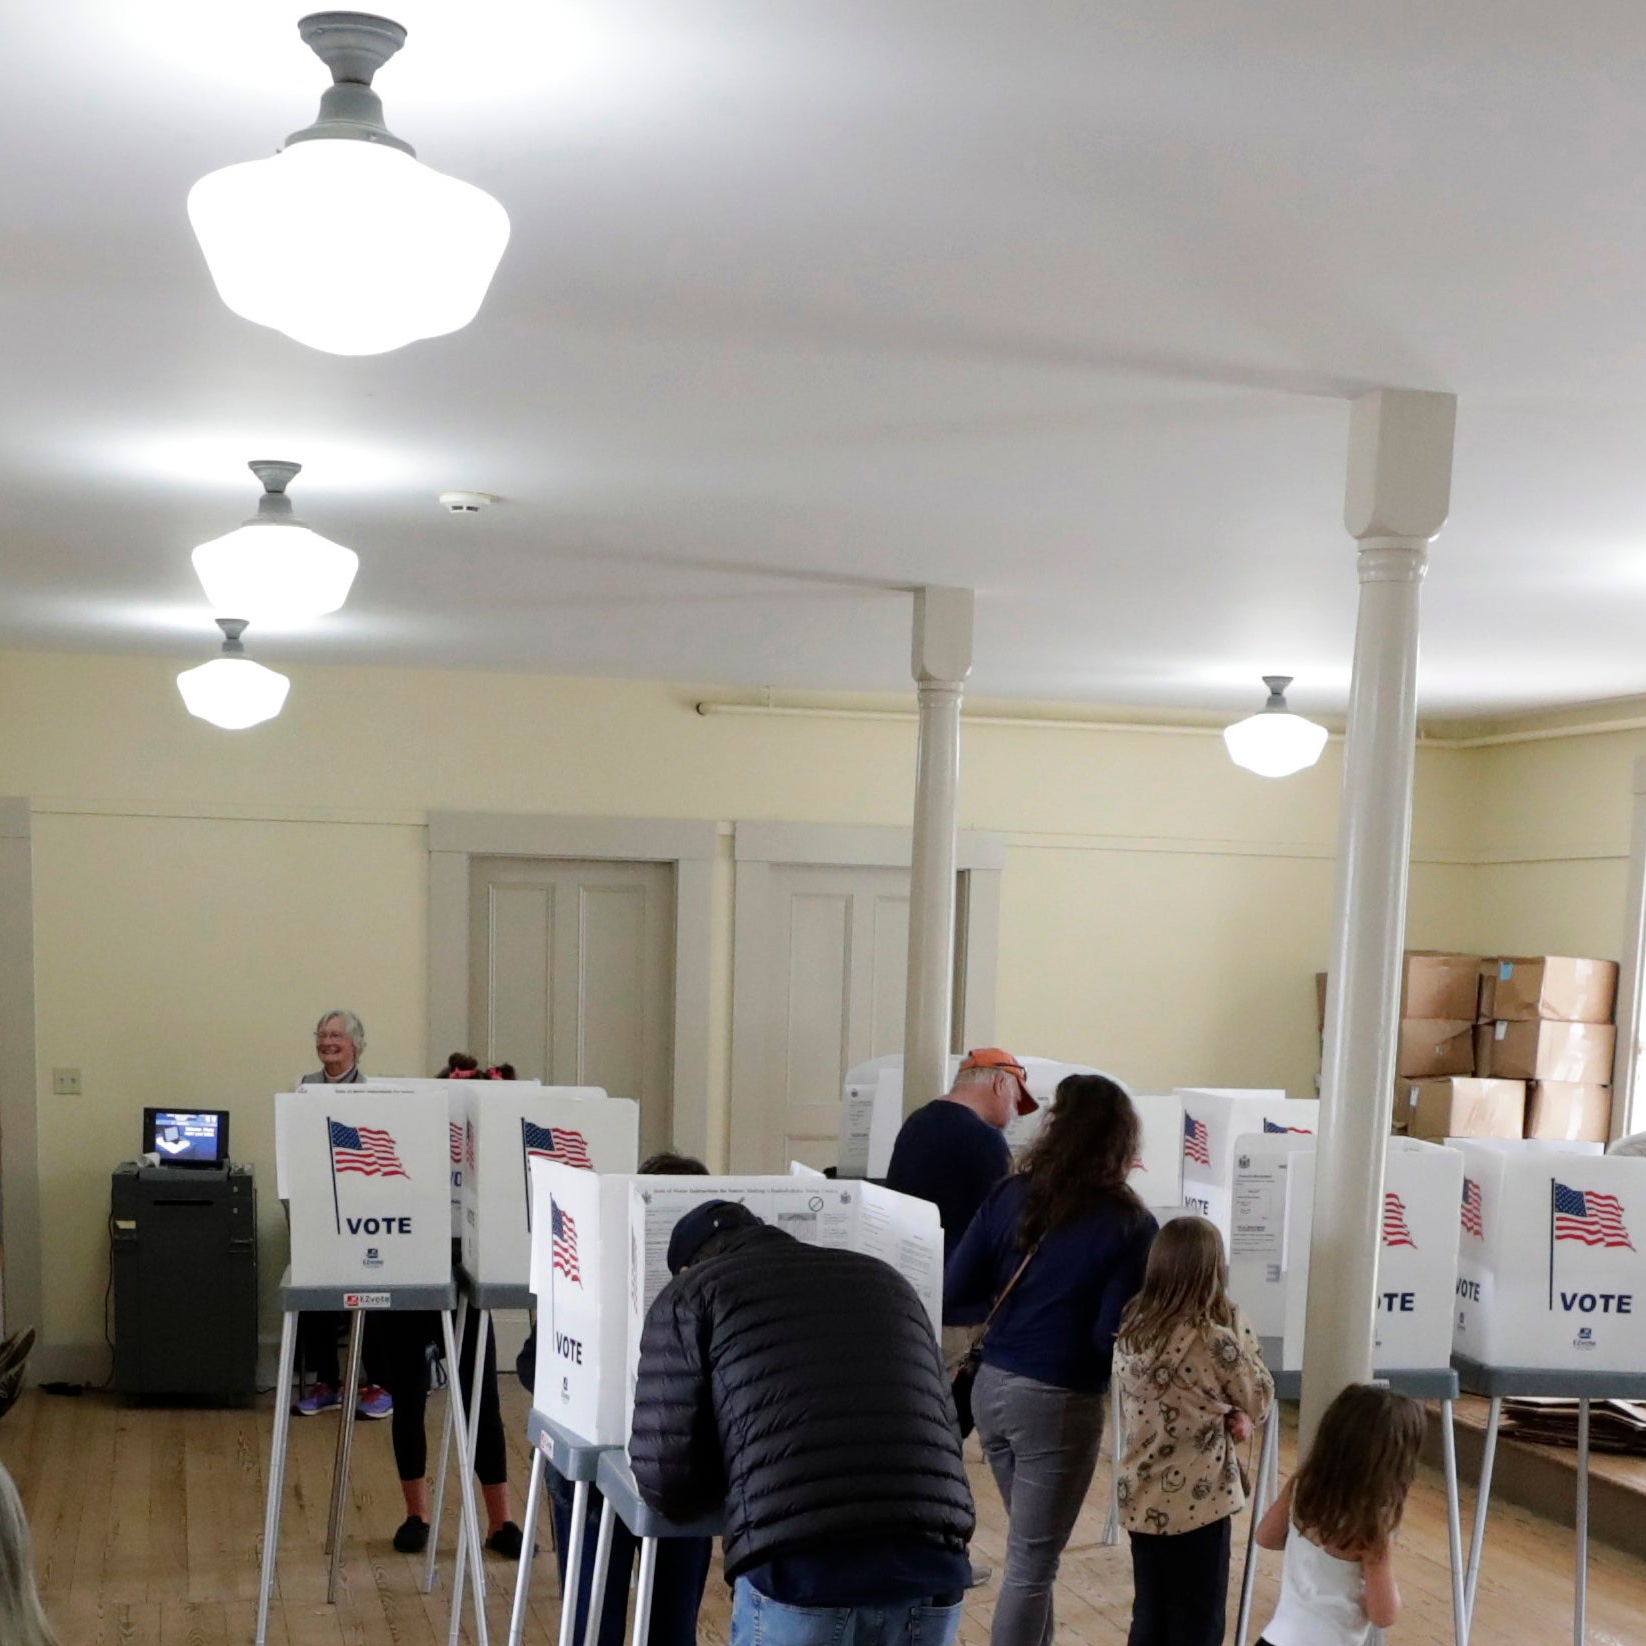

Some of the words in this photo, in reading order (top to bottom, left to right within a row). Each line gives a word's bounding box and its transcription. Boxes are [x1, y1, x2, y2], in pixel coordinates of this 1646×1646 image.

[346, 1217, 413, 1235] VOTE
[1456, 1278, 1481, 1302] VOTE
[1378, 1292, 1416, 1312] TE
[1560, 1292, 1633, 1314] VOTE
[556, 1331, 582, 1365] VOTE
